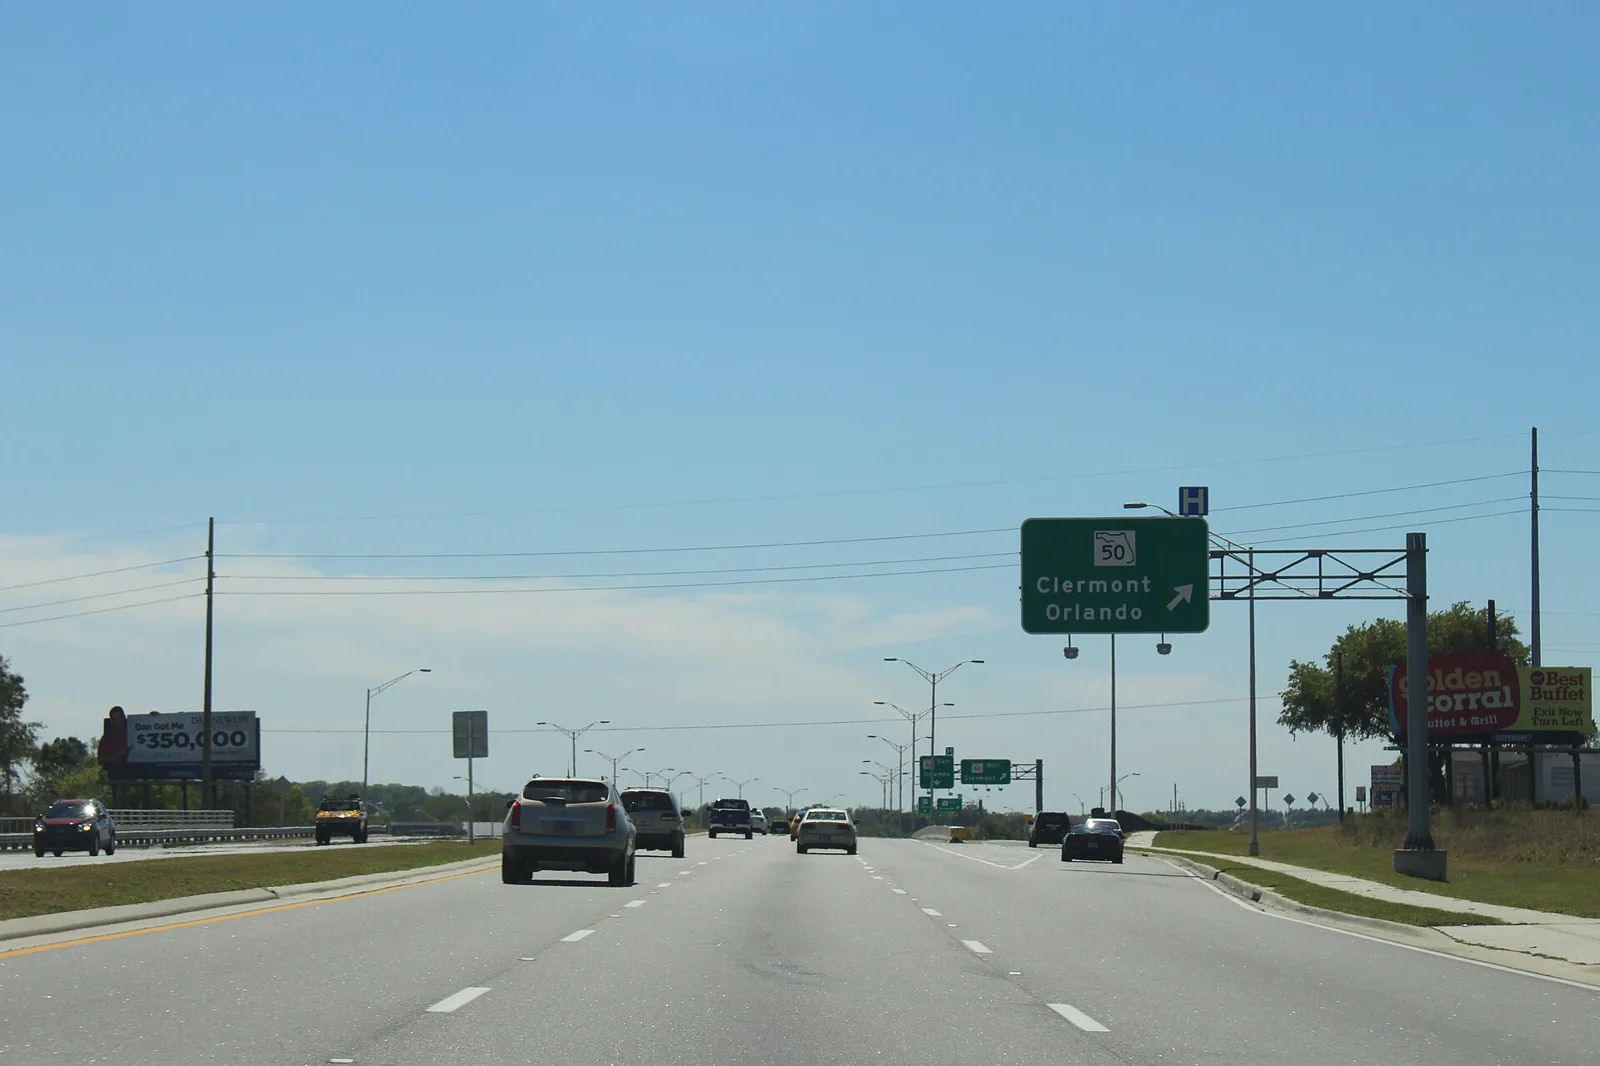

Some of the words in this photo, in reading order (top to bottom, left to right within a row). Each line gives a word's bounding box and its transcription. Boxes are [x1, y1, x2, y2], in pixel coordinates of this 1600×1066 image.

[1182, 488, 1205, 514] H
[1102, 544, 1126, 561] 50
[1036, 575, 1151, 594] Clermont
[1045, 604, 1142, 621] Orlando
[1545, 671, 1585, 687] Best
[1529, 686, 1585, 701] Buffet
[1533, 706, 1556, 717] Exit
[1558, 707, 1583, 717] Now
[134, 723, 152, 731] Dan
[154, 722, 169, 730] Got
[171, 722, 184, 730] Me
[1427, 717, 1456, 729] uffet
[1459, 715, 1467, 727] &
[1470, 714, 1498, 726] Grill
[1531, 717, 1559, 726] Turn
[1561, 717, 1584, 726] Left
[136, 730, 247, 750] $350,000
